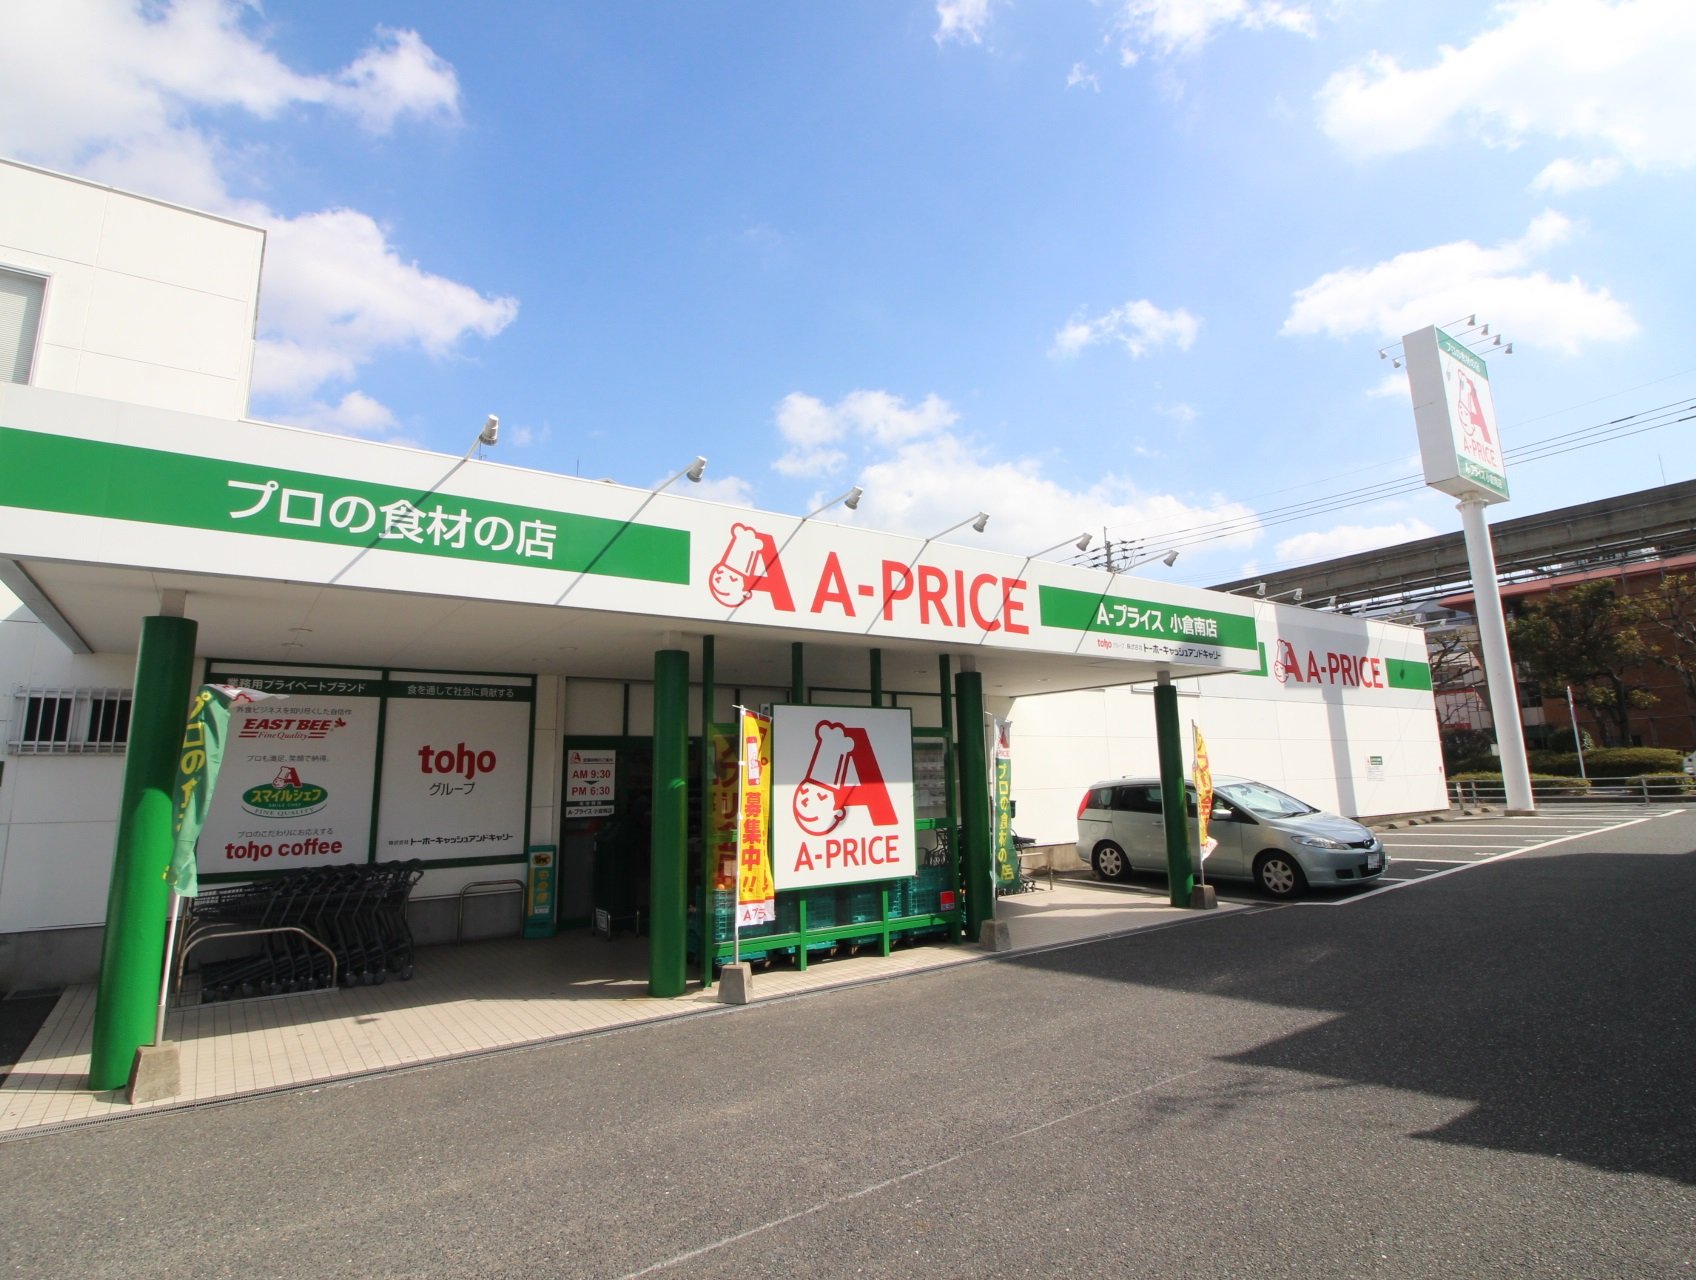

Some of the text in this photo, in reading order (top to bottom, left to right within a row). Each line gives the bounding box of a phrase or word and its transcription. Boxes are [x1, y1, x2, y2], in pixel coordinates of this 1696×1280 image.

[228, 480, 557, 560] プロの食材の店
[810, 551, 1029, 635] A-PRICE
[1096, 602, 1218, 639] A-プライス 小倉南店
[1143, 643, 1222, 660] トーホーキャッシュアンドキャリー
[1307, 650, 1384, 689] A-PRICE
[407, 684, 515, 698] 食を通して社会に貢献する
[243, 718, 333, 731] EAST BEE
[418, 742, 497, 780] toho
[572, 769, 611, 779] AM 9:30
[251, 789, 323, 804] スマイルシェフ
[429, 782, 476, 797] グループ
[571, 786, 610, 796] PM 6:30
[410, 833, 514, 847] トーホーキャッシュアンドキャリー
[224, 838, 343, 862] toho coffee
[794, 835, 900, 872] A-PRICE
